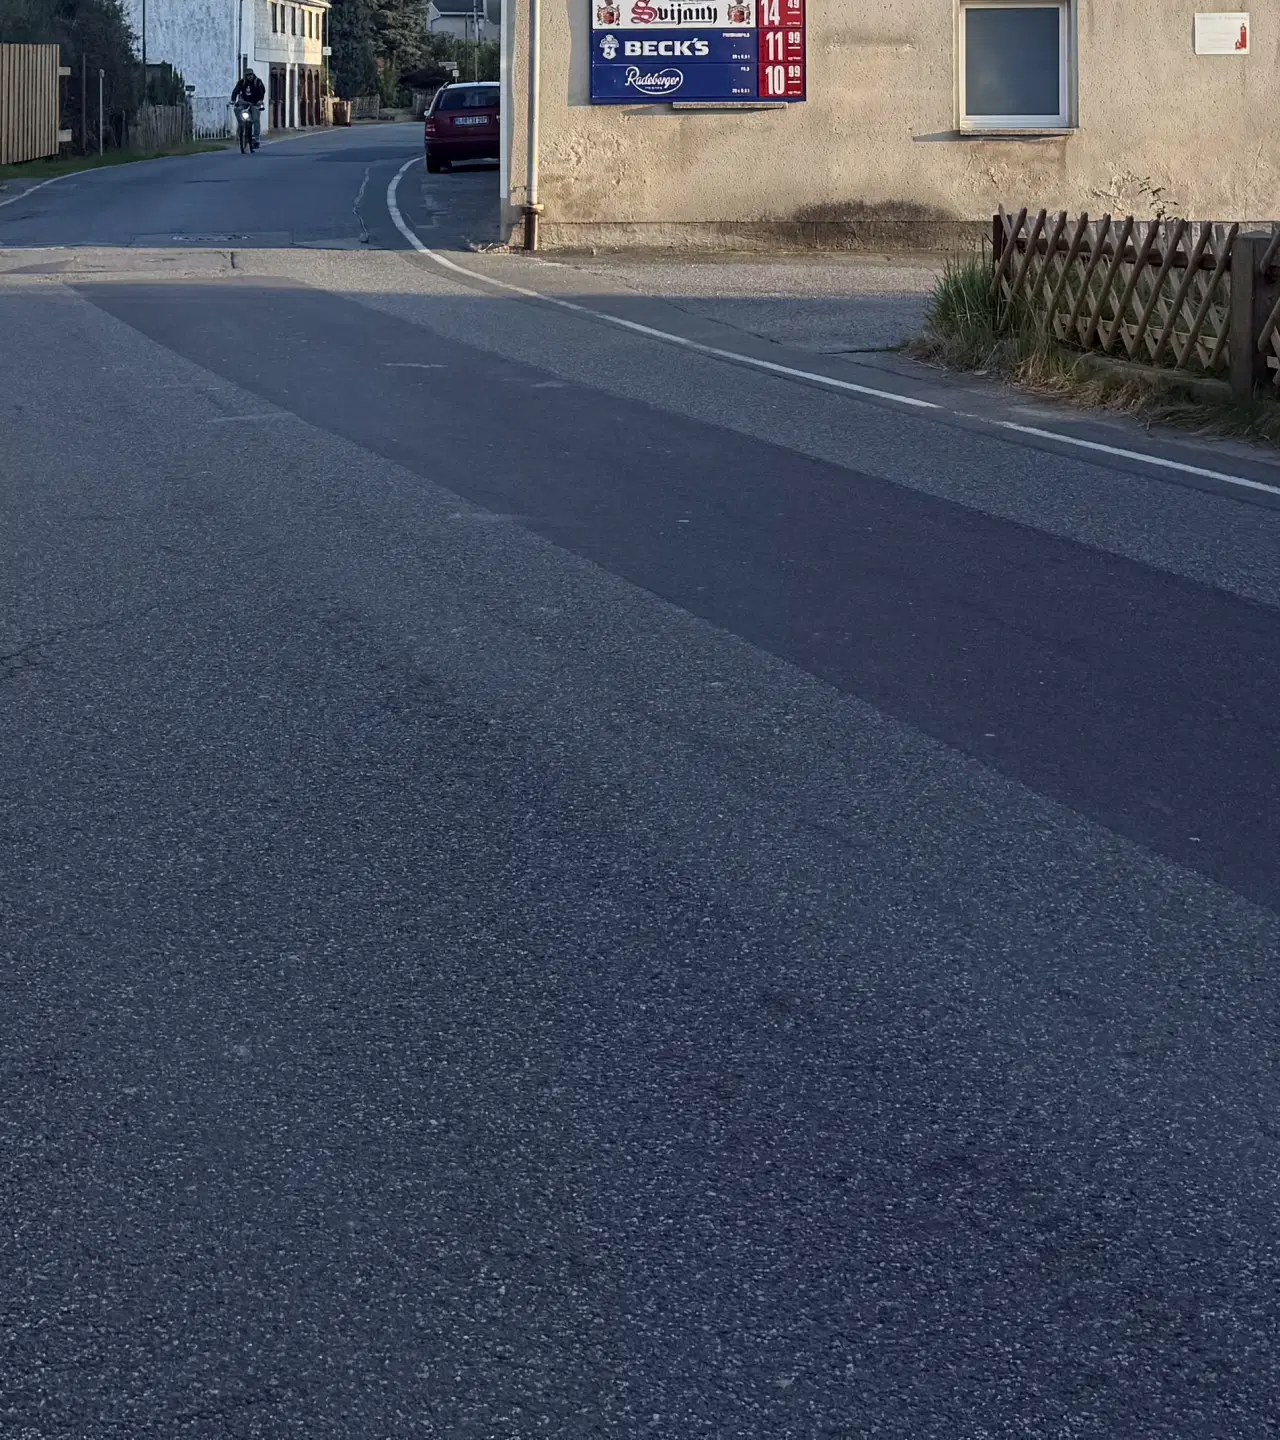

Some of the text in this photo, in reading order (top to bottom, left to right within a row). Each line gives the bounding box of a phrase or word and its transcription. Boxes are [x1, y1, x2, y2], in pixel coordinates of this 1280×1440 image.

[624, 38, 709, 56] BECK'S
[766, 31, 801, 61] 11 99
[625, 66, 680, 90] Radeberger
[765, 65, 801, 95] 10 99
